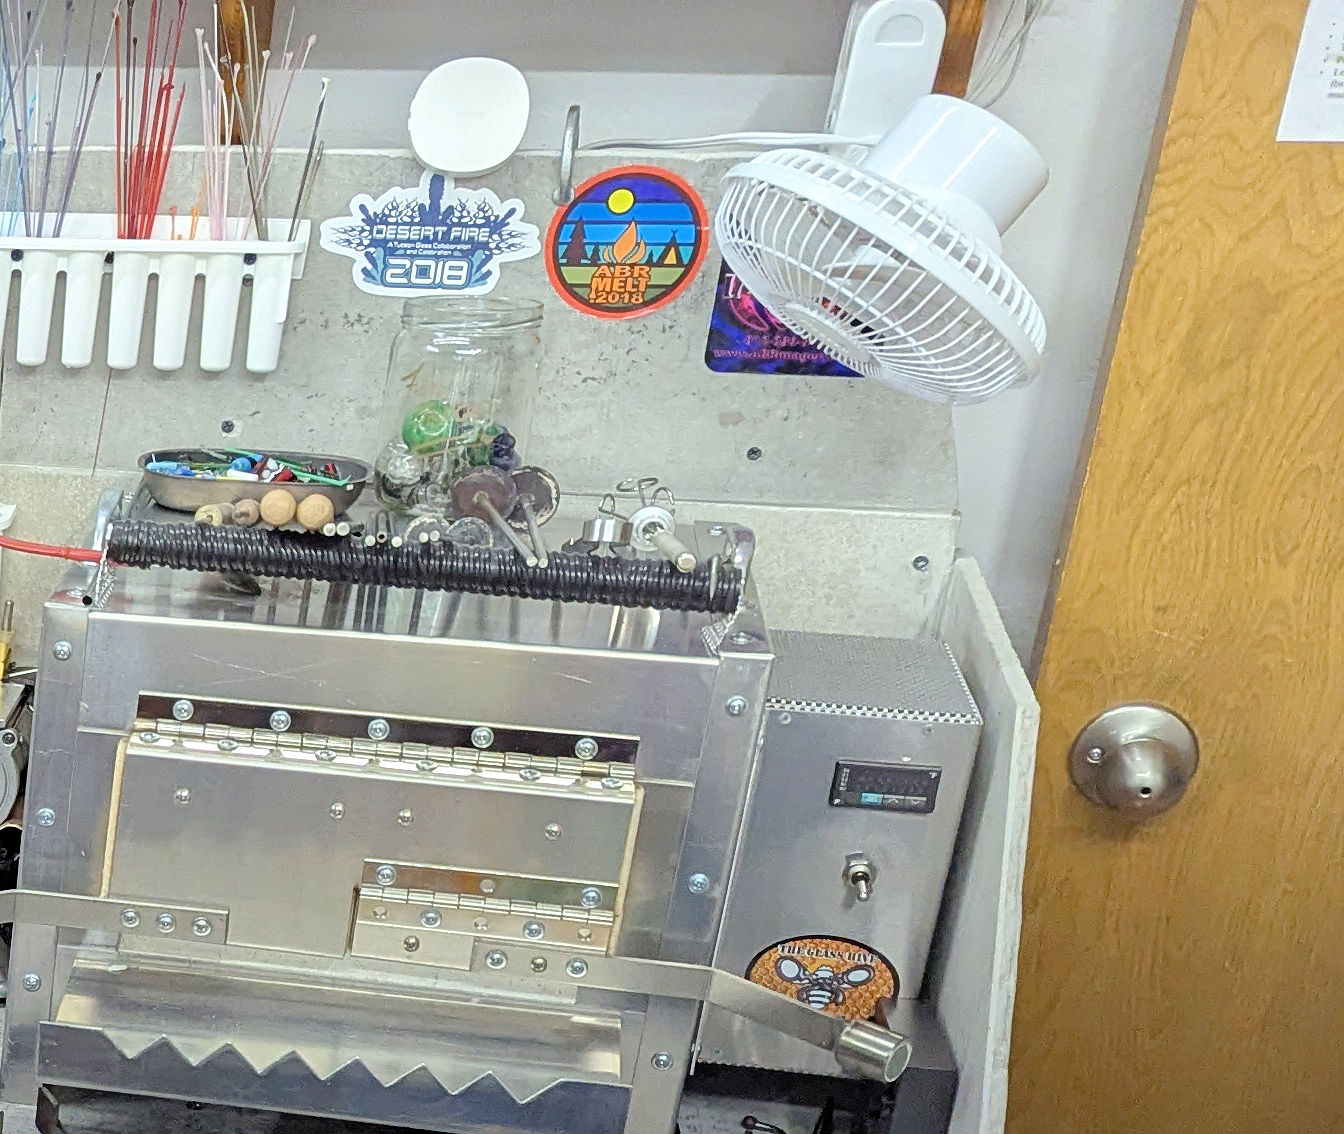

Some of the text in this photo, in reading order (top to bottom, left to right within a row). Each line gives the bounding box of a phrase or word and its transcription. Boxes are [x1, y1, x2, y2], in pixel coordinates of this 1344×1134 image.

[373, 225, 491, 242] DESERT FIRE
[385, 258, 469, 286] 2018
[593, 265, 651, 278] ABR
[590, 277, 649, 294] MELT
[777, 944, 804, 955] THE
